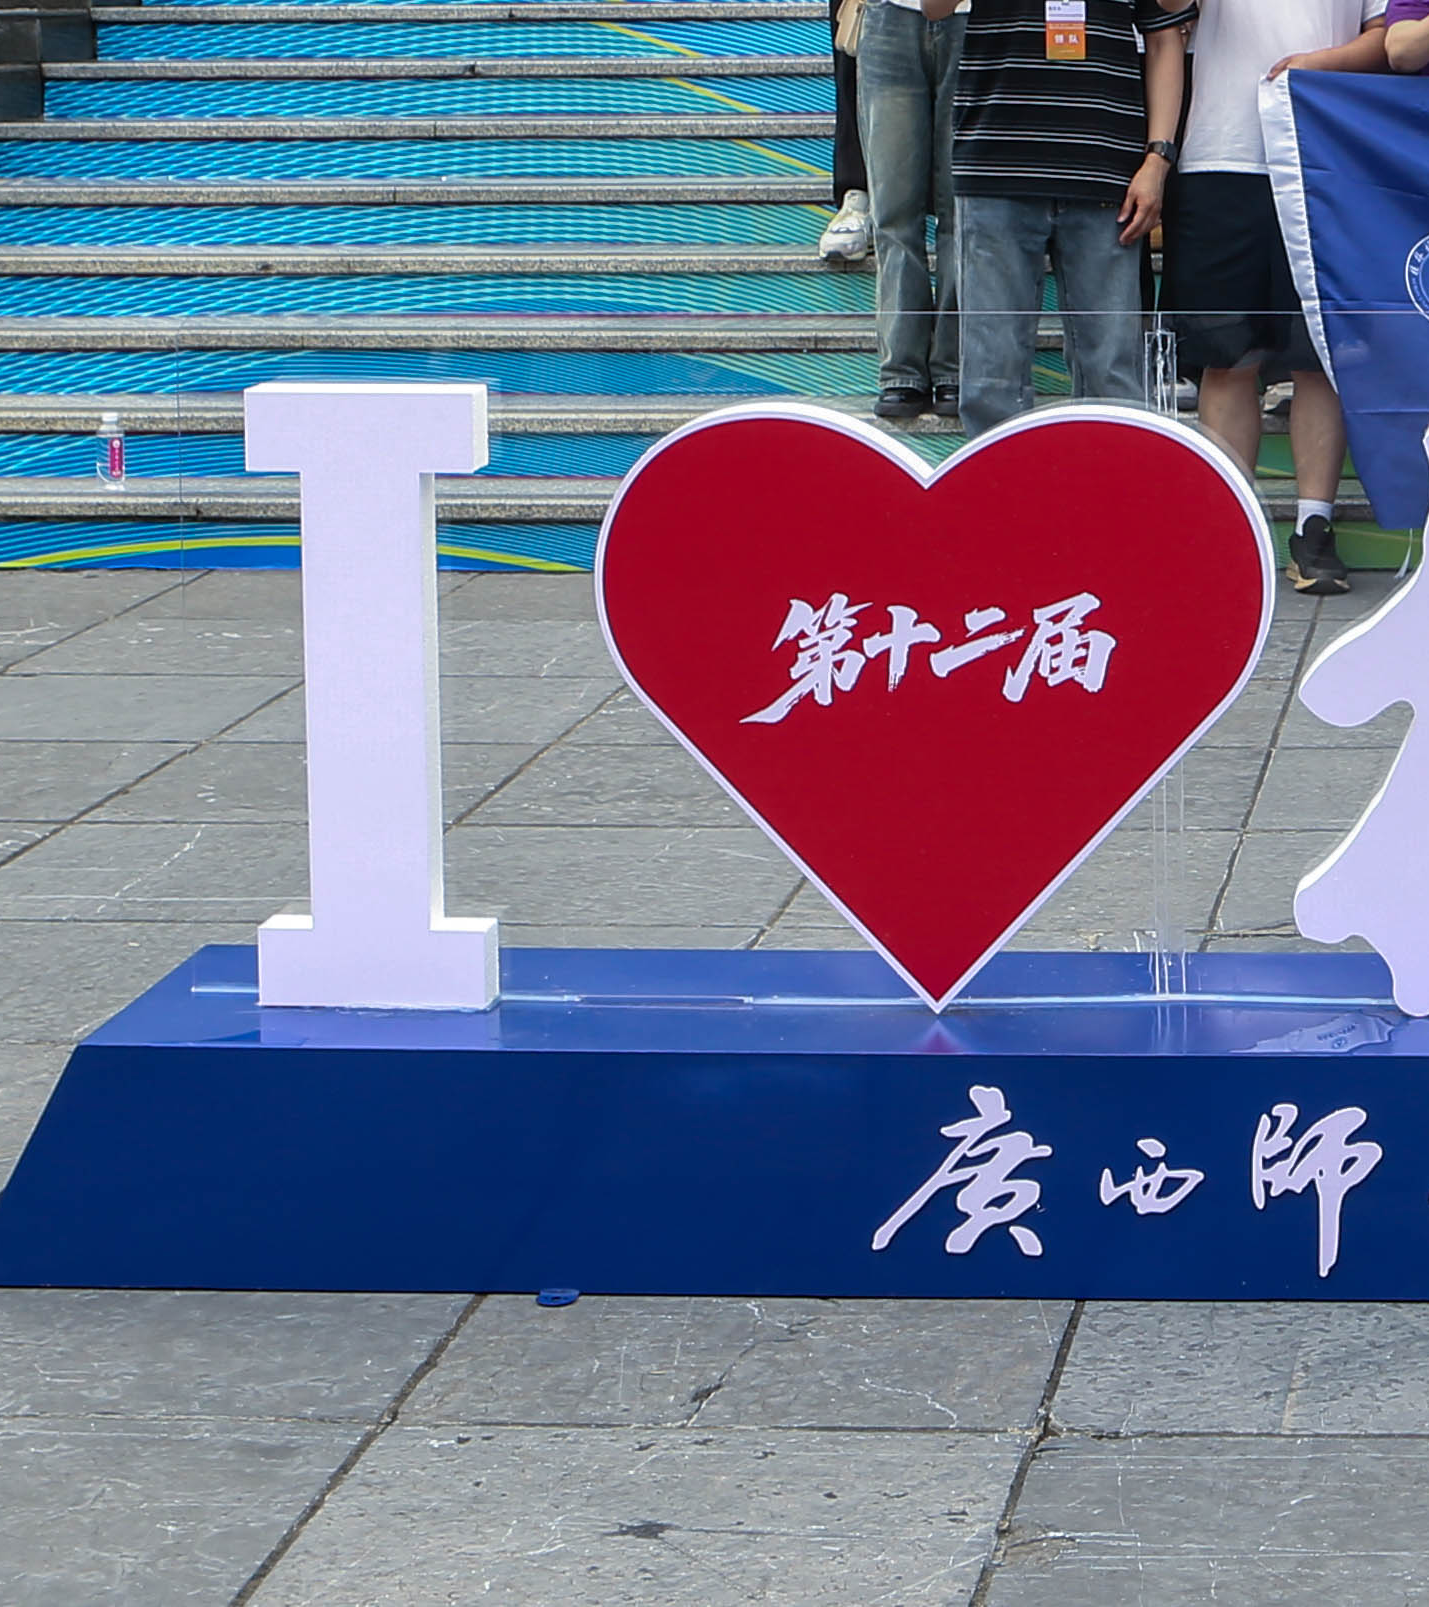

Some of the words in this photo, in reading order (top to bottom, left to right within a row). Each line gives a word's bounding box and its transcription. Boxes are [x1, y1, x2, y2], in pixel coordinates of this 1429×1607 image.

[243, 380, 499, 1009] I
[739, 593, 1117, 724] 第十二届
